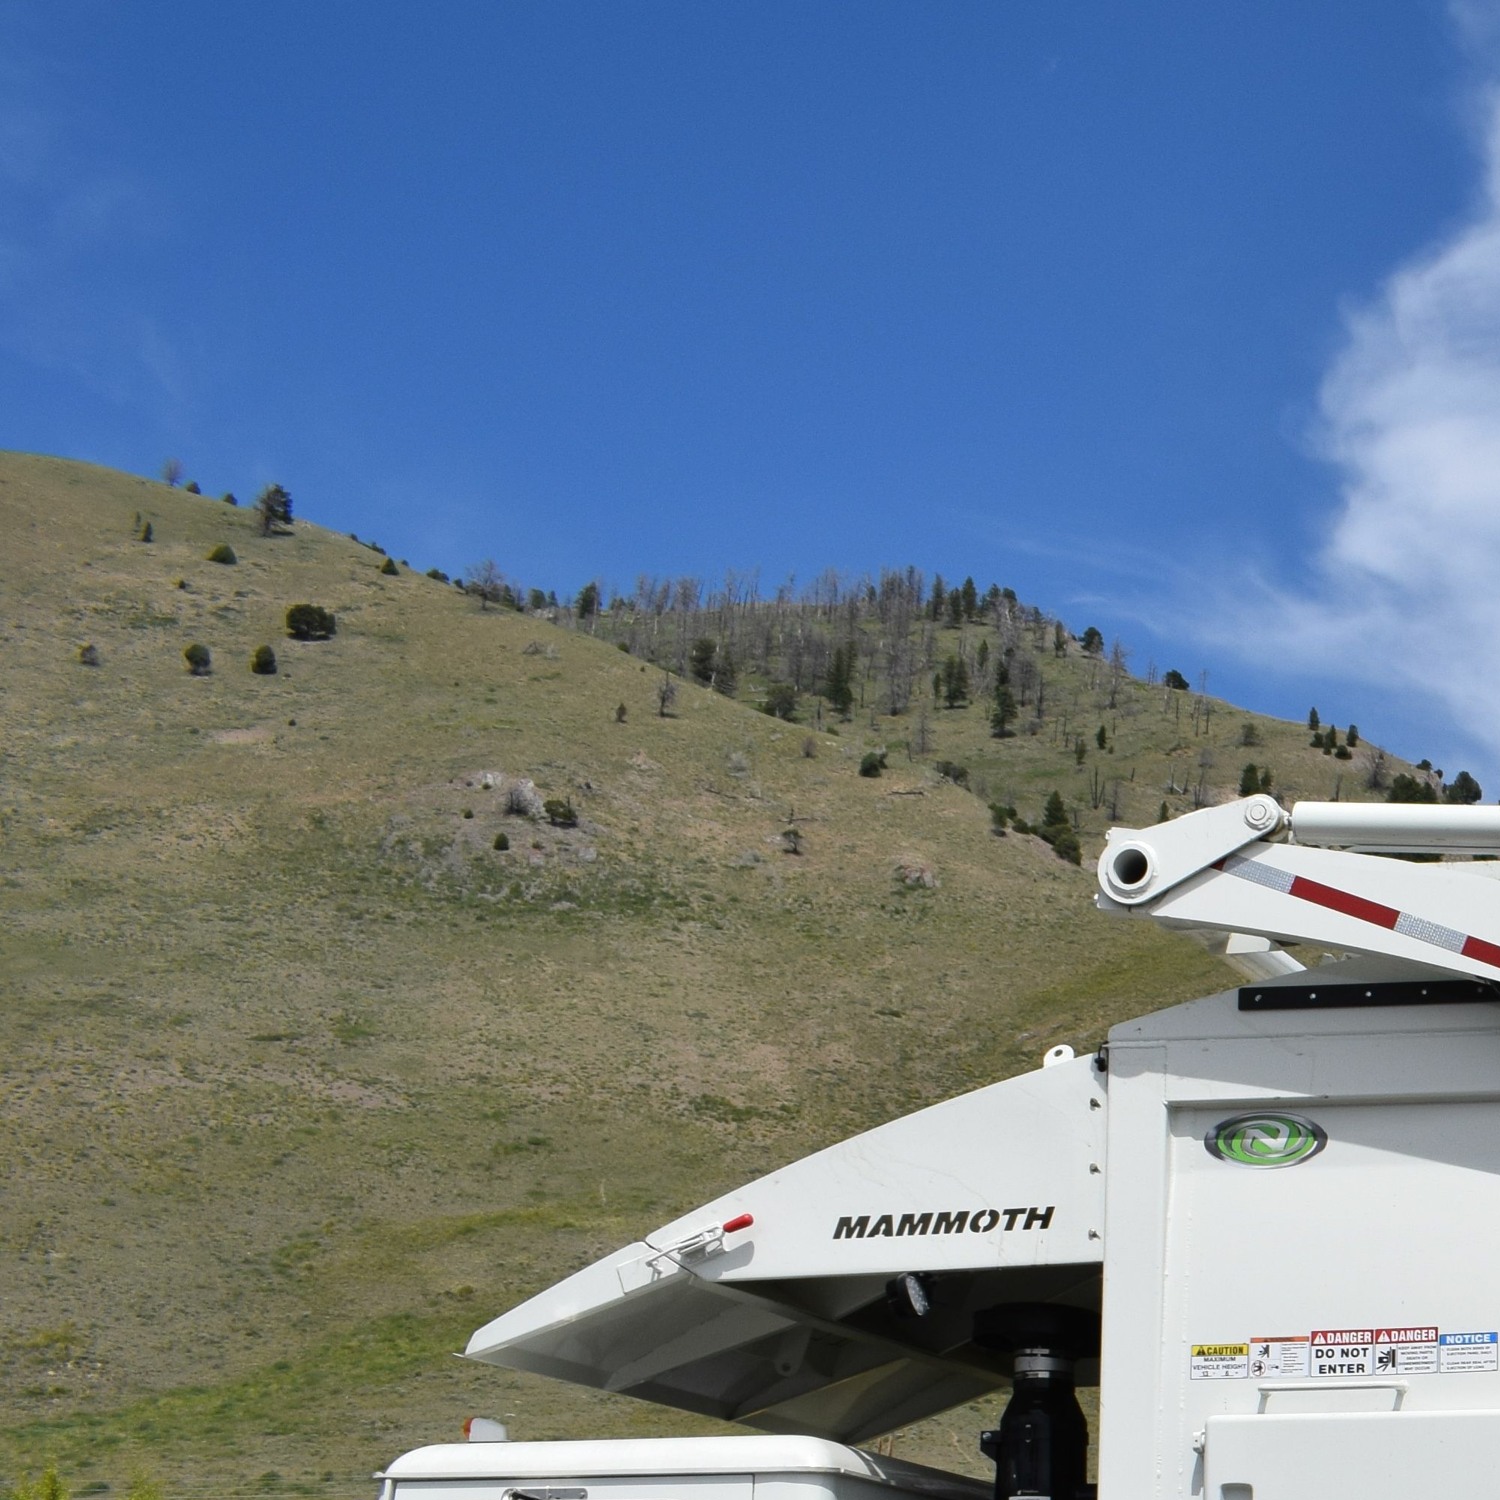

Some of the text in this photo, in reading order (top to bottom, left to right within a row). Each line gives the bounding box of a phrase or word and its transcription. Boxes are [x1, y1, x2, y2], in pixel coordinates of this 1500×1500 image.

[832, 1206, 1055, 1239] MAMMOTH
[1327, 1332, 1372, 1344] DANGER
[1391, 1330, 1436, 1342] DANGER
[1446, 1334, 1491, 1344] NOTICE
[1207, 1346, 1244, 1355] CAUTION
[1315, 1348, 1369, 1358] DO NOT
[1319, 1364, 1365, 1374] ENTER
